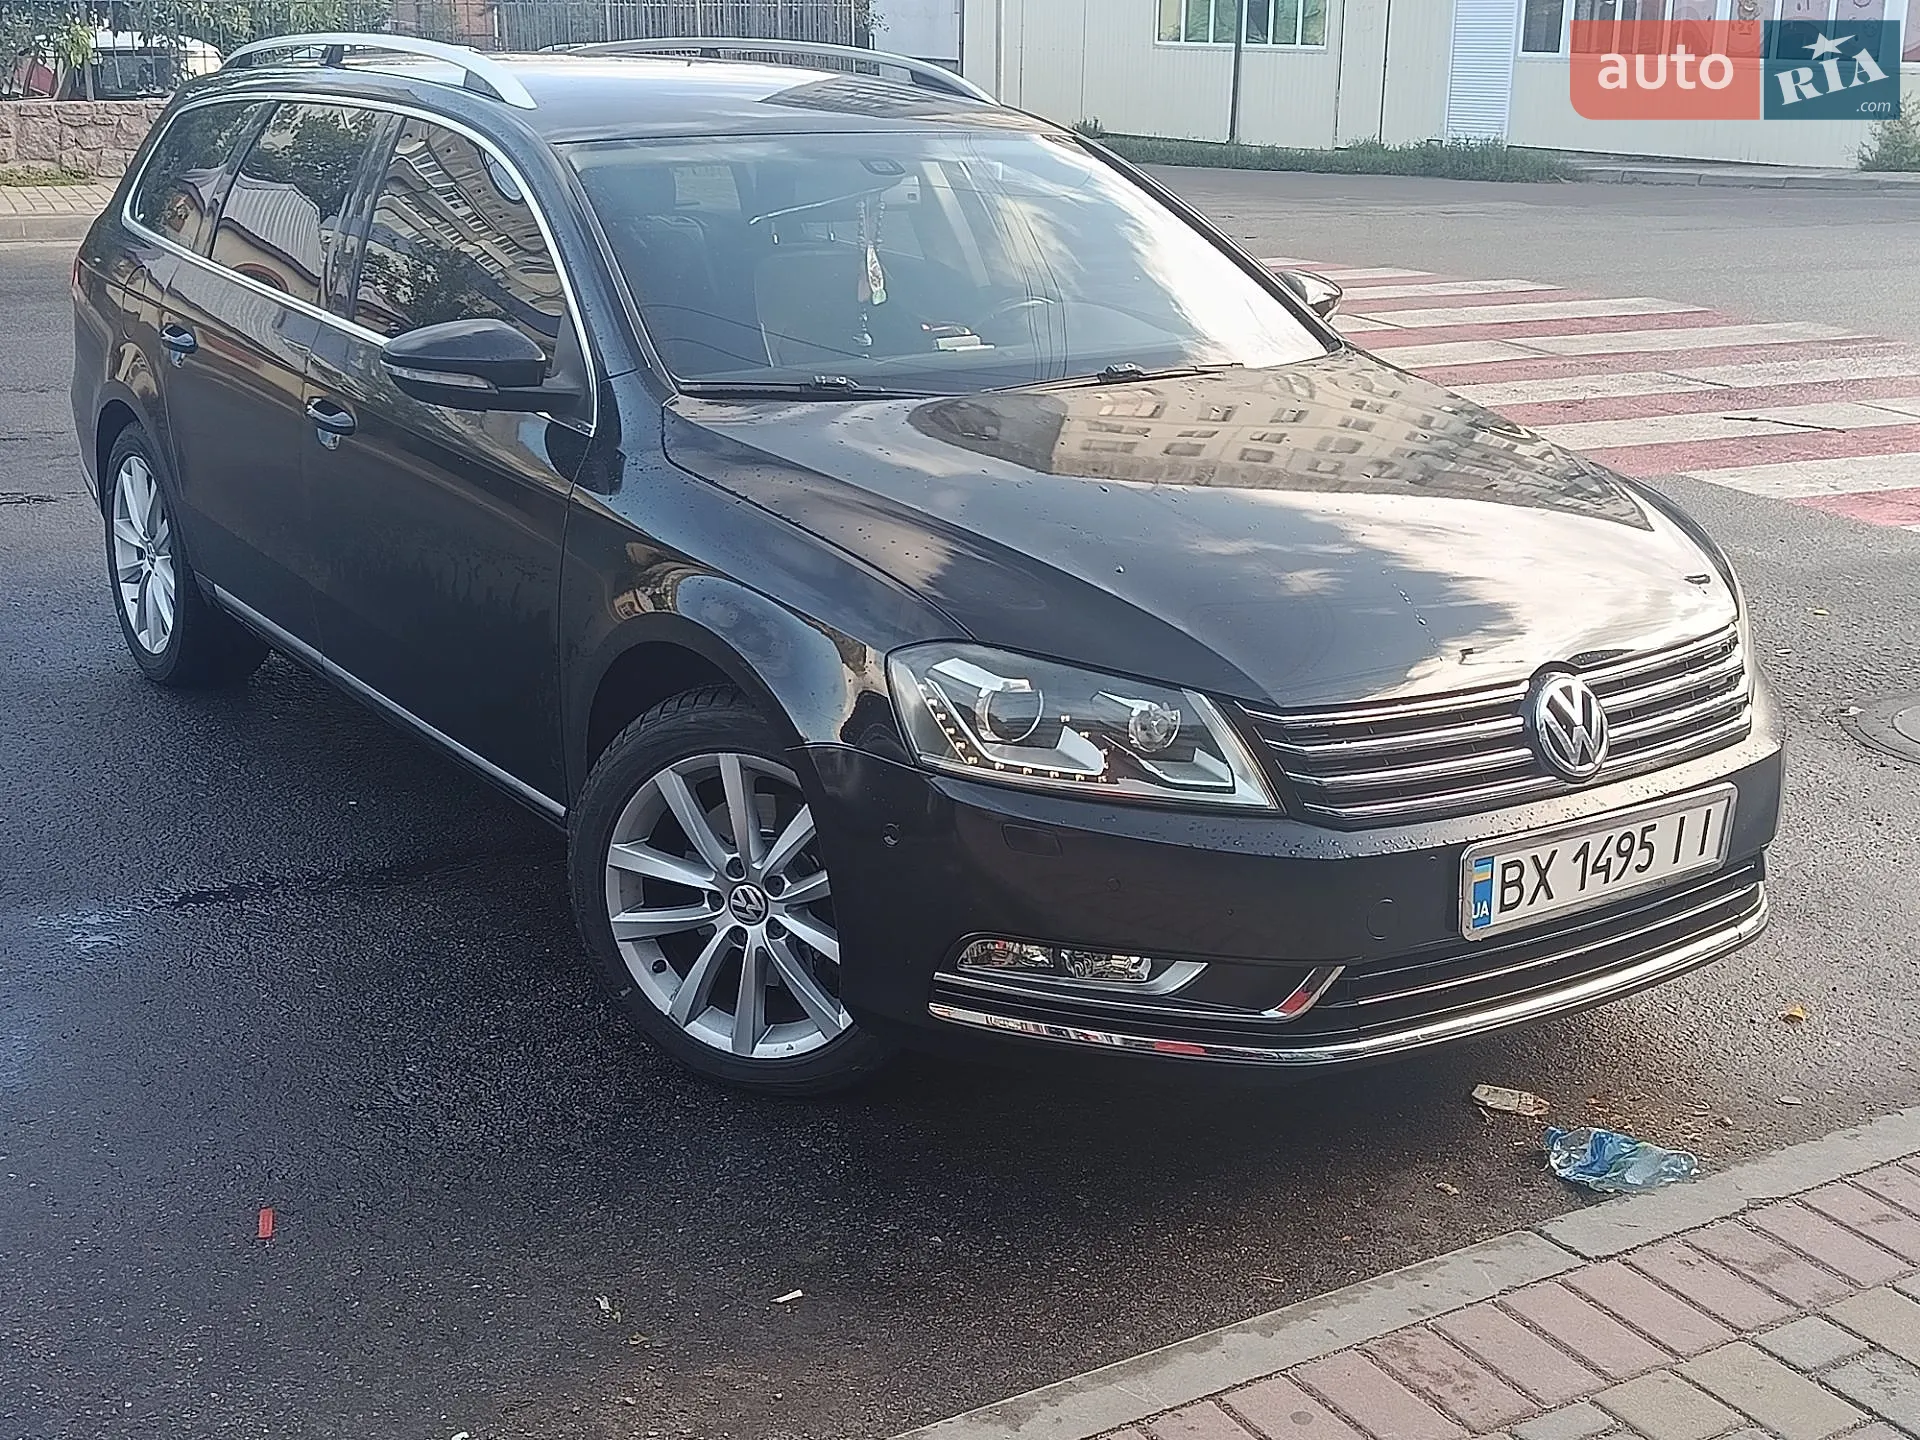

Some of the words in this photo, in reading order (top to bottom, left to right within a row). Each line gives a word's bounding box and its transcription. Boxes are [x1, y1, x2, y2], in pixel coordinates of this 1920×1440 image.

[1499, 848, 1558, 913] BX
[1572, 823, 1657, 891] 1495
[1472, 900, 1489, 919] UA
